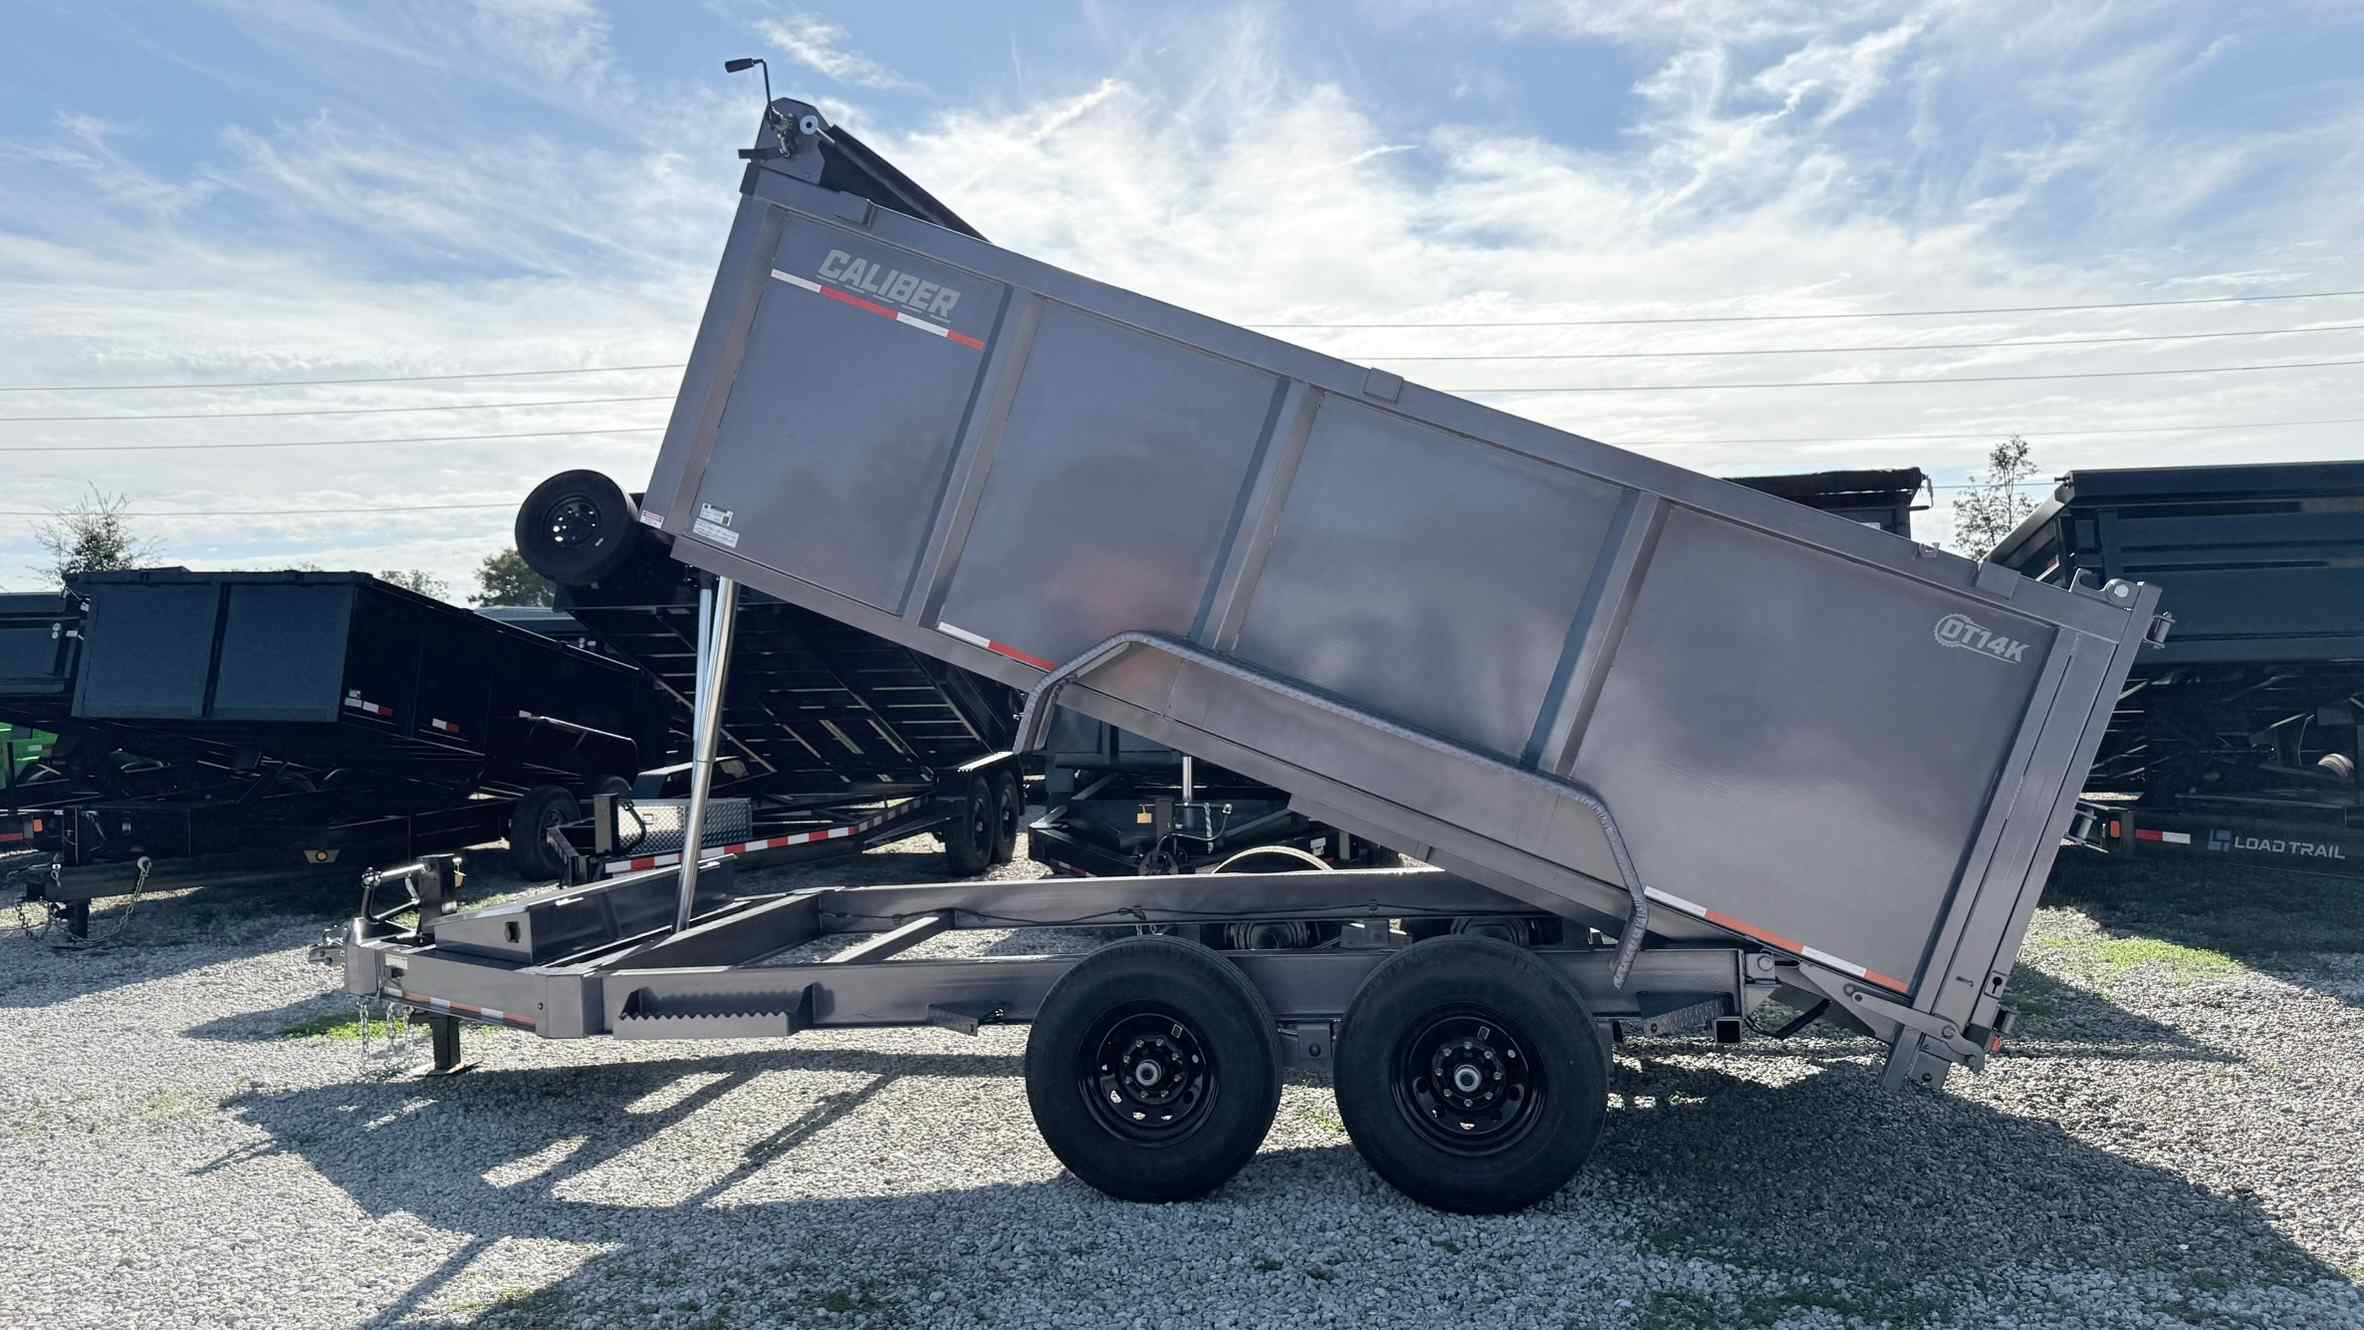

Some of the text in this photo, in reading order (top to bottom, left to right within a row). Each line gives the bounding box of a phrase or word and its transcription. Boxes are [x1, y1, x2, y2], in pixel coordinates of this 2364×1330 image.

[819, 249, 960, 317] CALIBER
[2235, 836, 2346, 859] LOAD TRAIL
